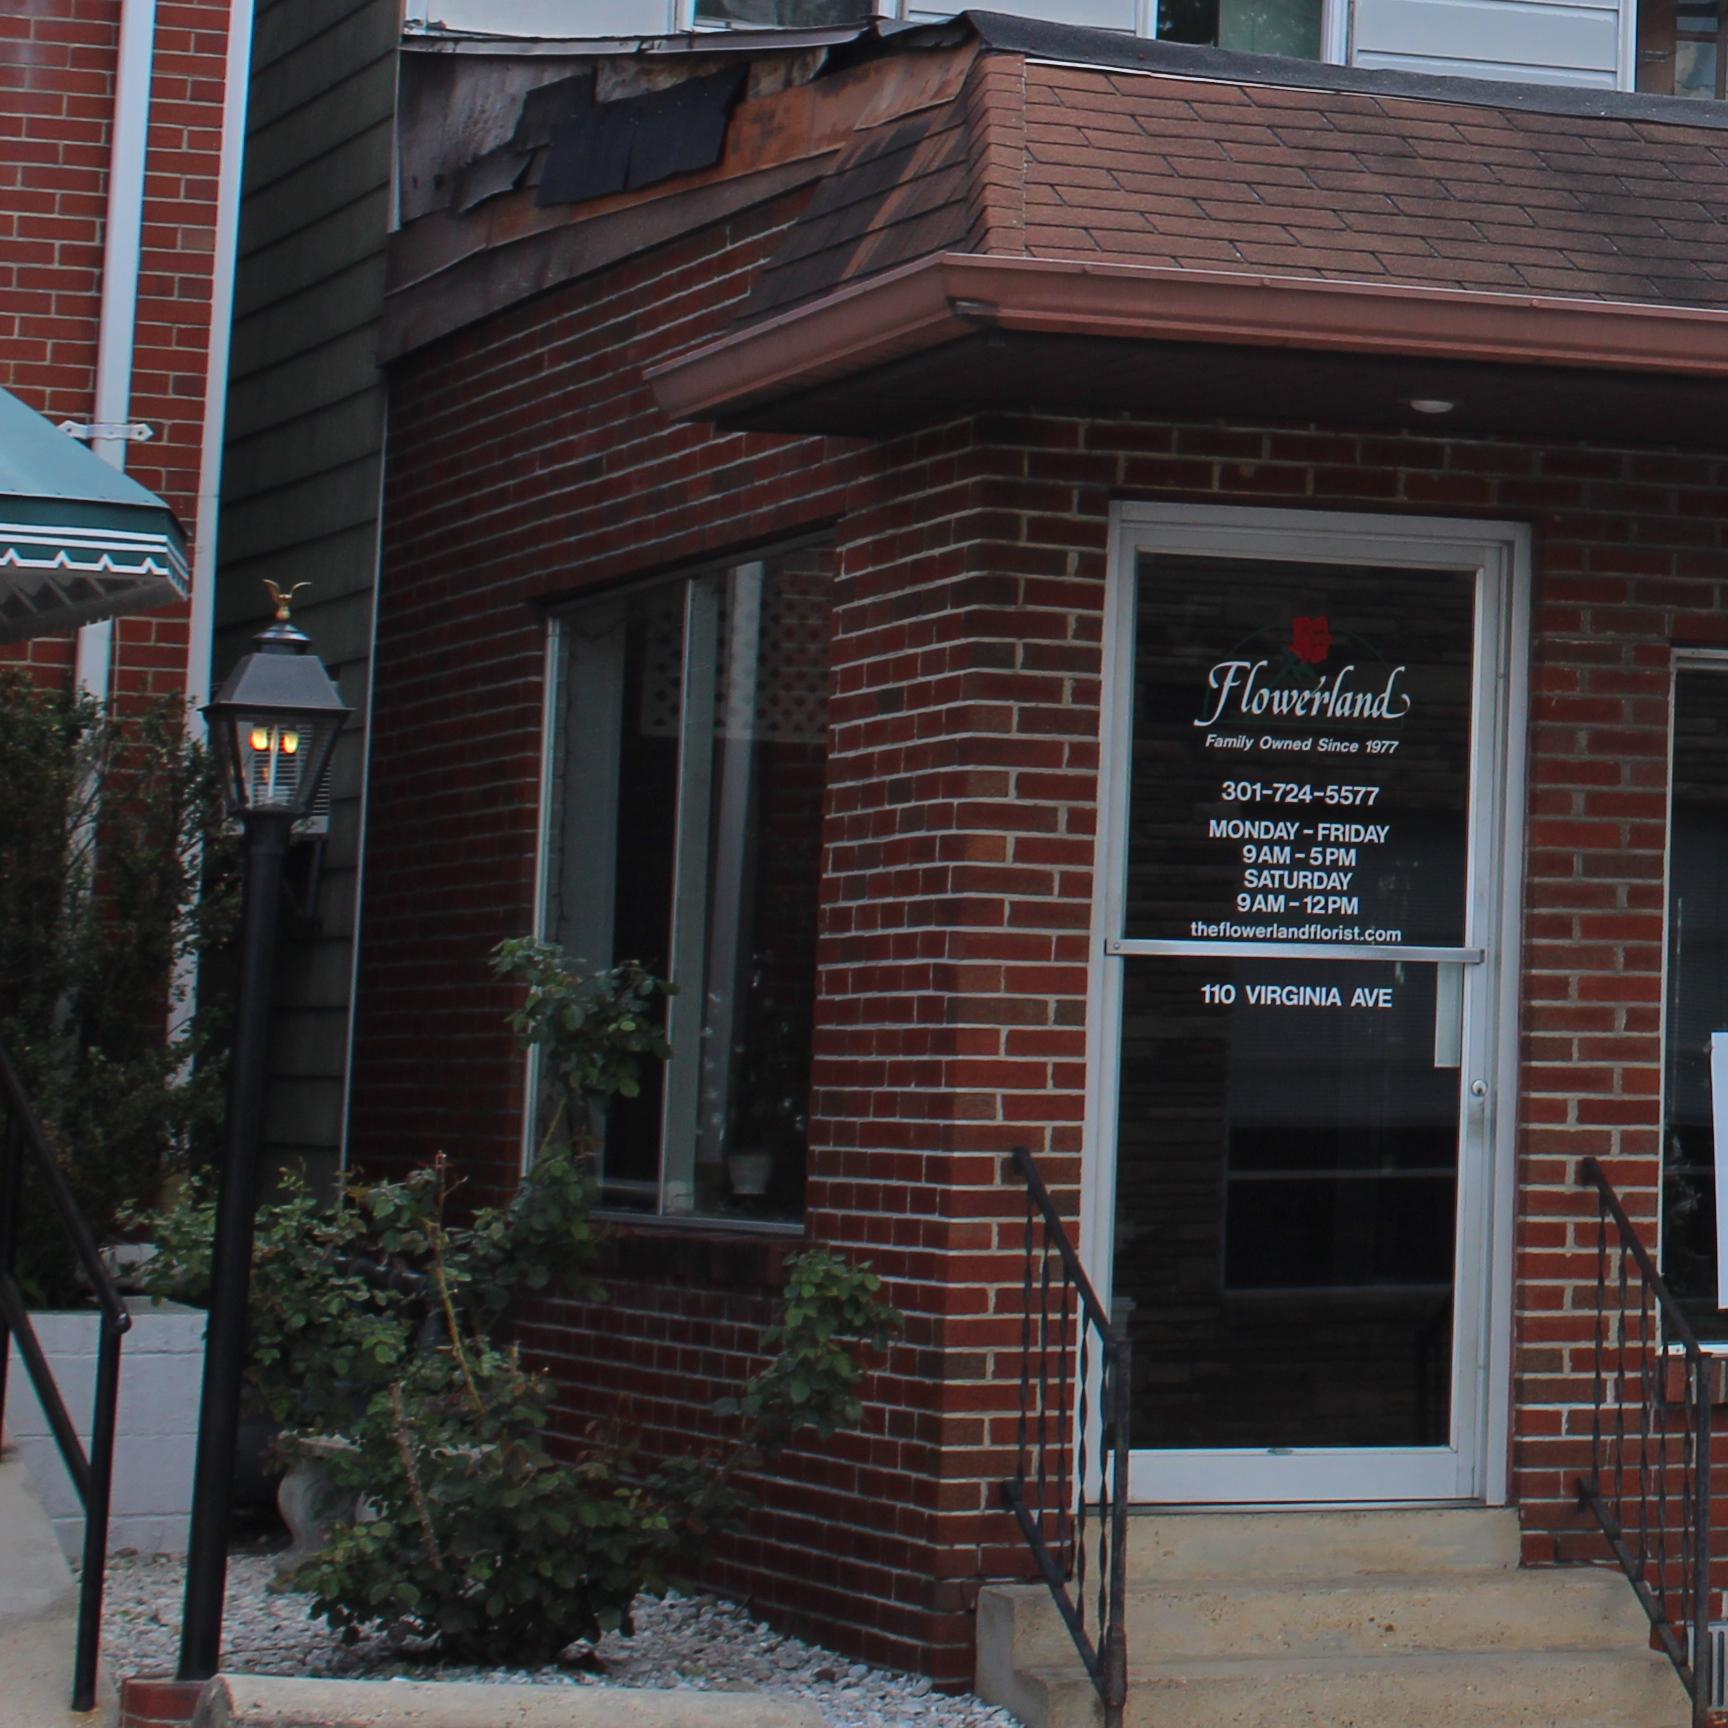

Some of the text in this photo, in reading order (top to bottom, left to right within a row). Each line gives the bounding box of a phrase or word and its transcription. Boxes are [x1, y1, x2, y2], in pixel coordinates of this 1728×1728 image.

[1193, 659, 1411, 727] Flowerland
[1205, 733, 1399, 754] Family Owned Since 1977
[1221, 780, 1380, 806] 301-724-5577
[1208, 819, 1299, 840] MONDAY
[1318, 823, 1390, 843] FRIDAY
[1243, 869, 1352, 890] SATURDAY
[1190, 921, 1402, 942] theflowerlandflorist.com
[1200, 983, 1393, 1008] 110 VIRGINIA AVE
